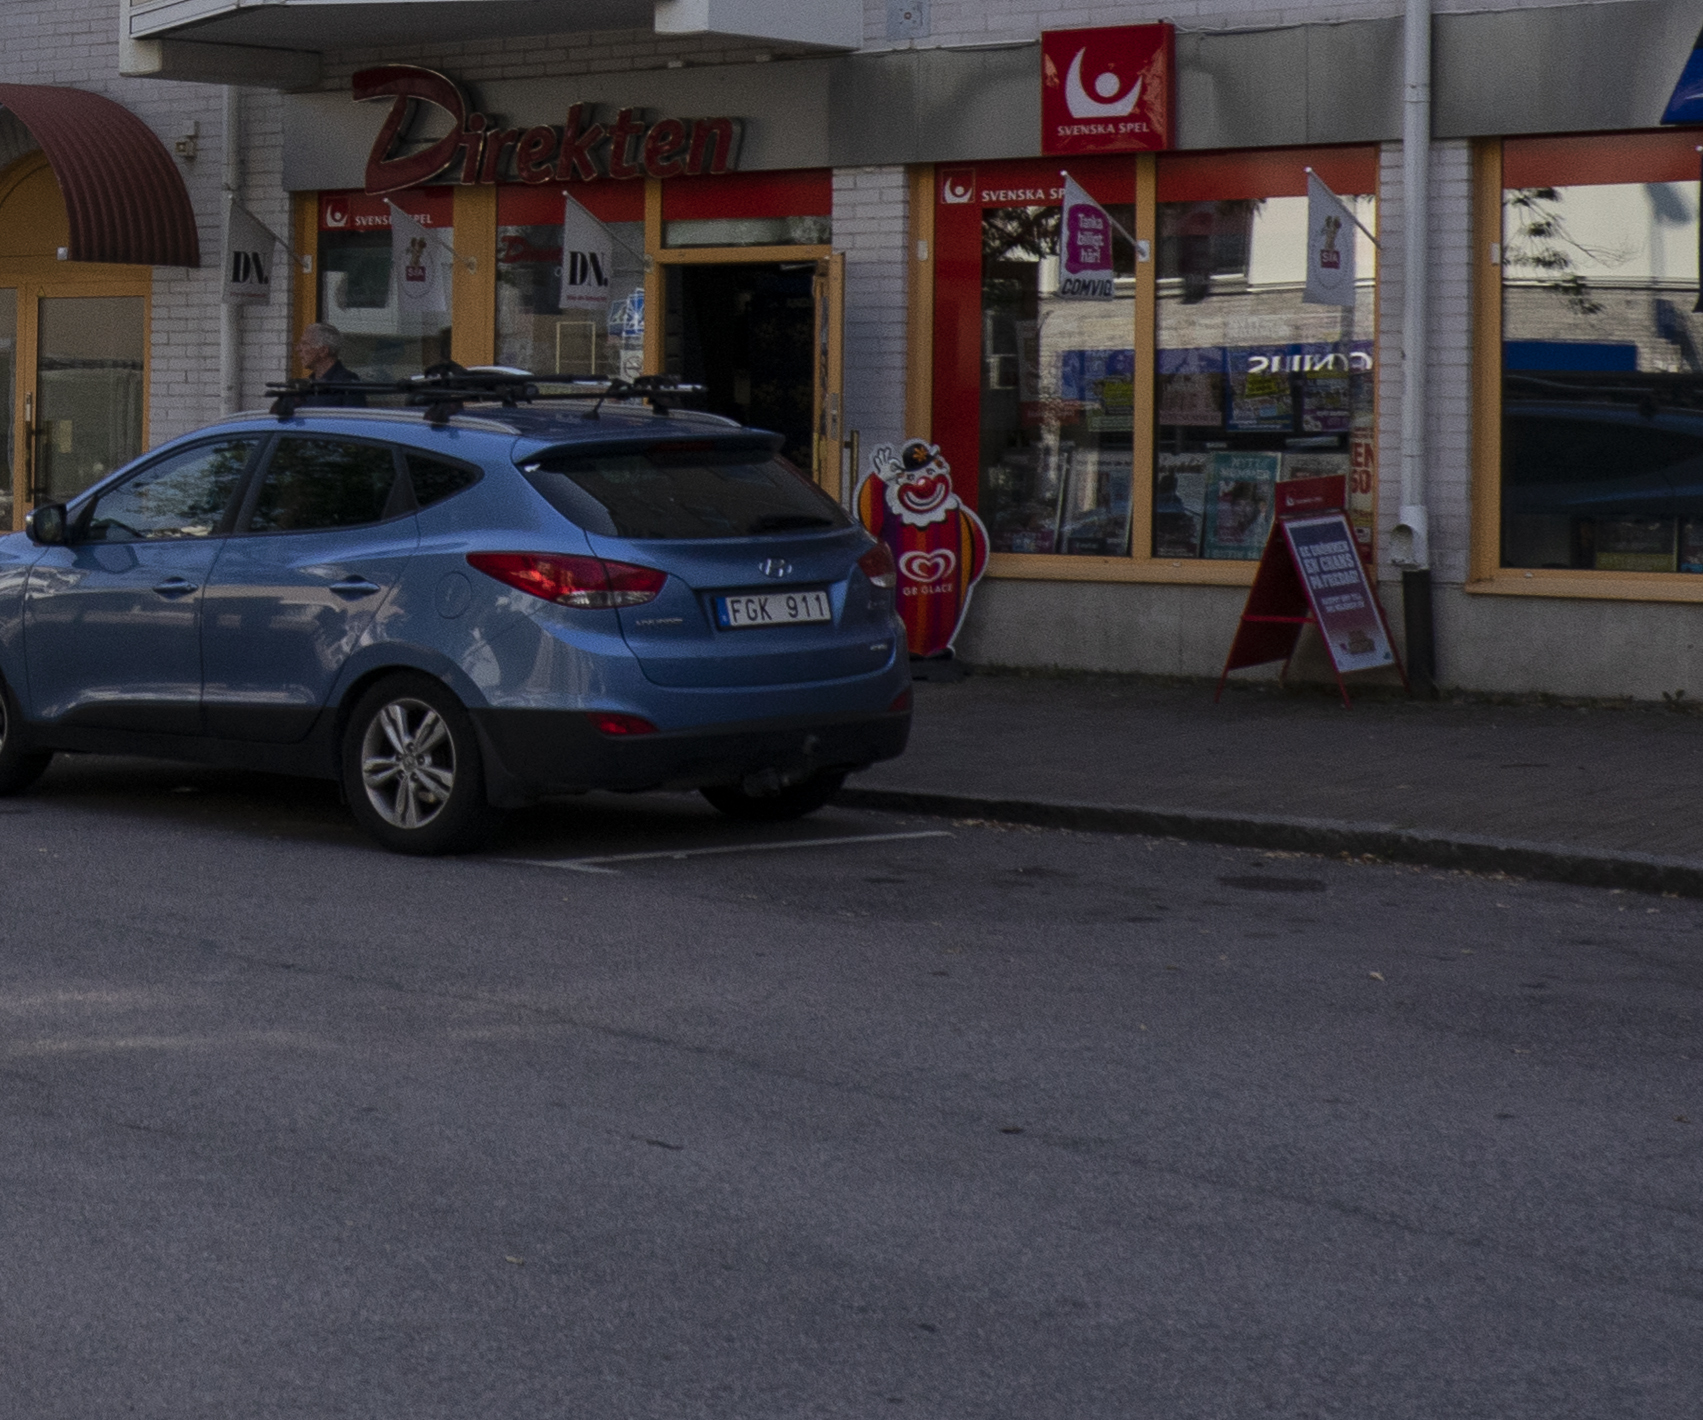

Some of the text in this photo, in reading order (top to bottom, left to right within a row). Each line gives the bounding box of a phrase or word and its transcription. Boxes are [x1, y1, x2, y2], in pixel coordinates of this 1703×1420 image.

[352, 63, 738, 195] Direkten
[1056, 122, 1151, 136] SVENSKA SPEL
[981, 189, 1046, 201] SVENSKA
[1077, 213, 1104, 230] Tanka
[1077, 231, 1105, 248] billigt
[568, 251, 609, 287] DN.
[1061, 279, 1113, 297] COMVIQ
[921, 584, 953, 595] GLACE
[730, 594, 825, 624] FGK 911
